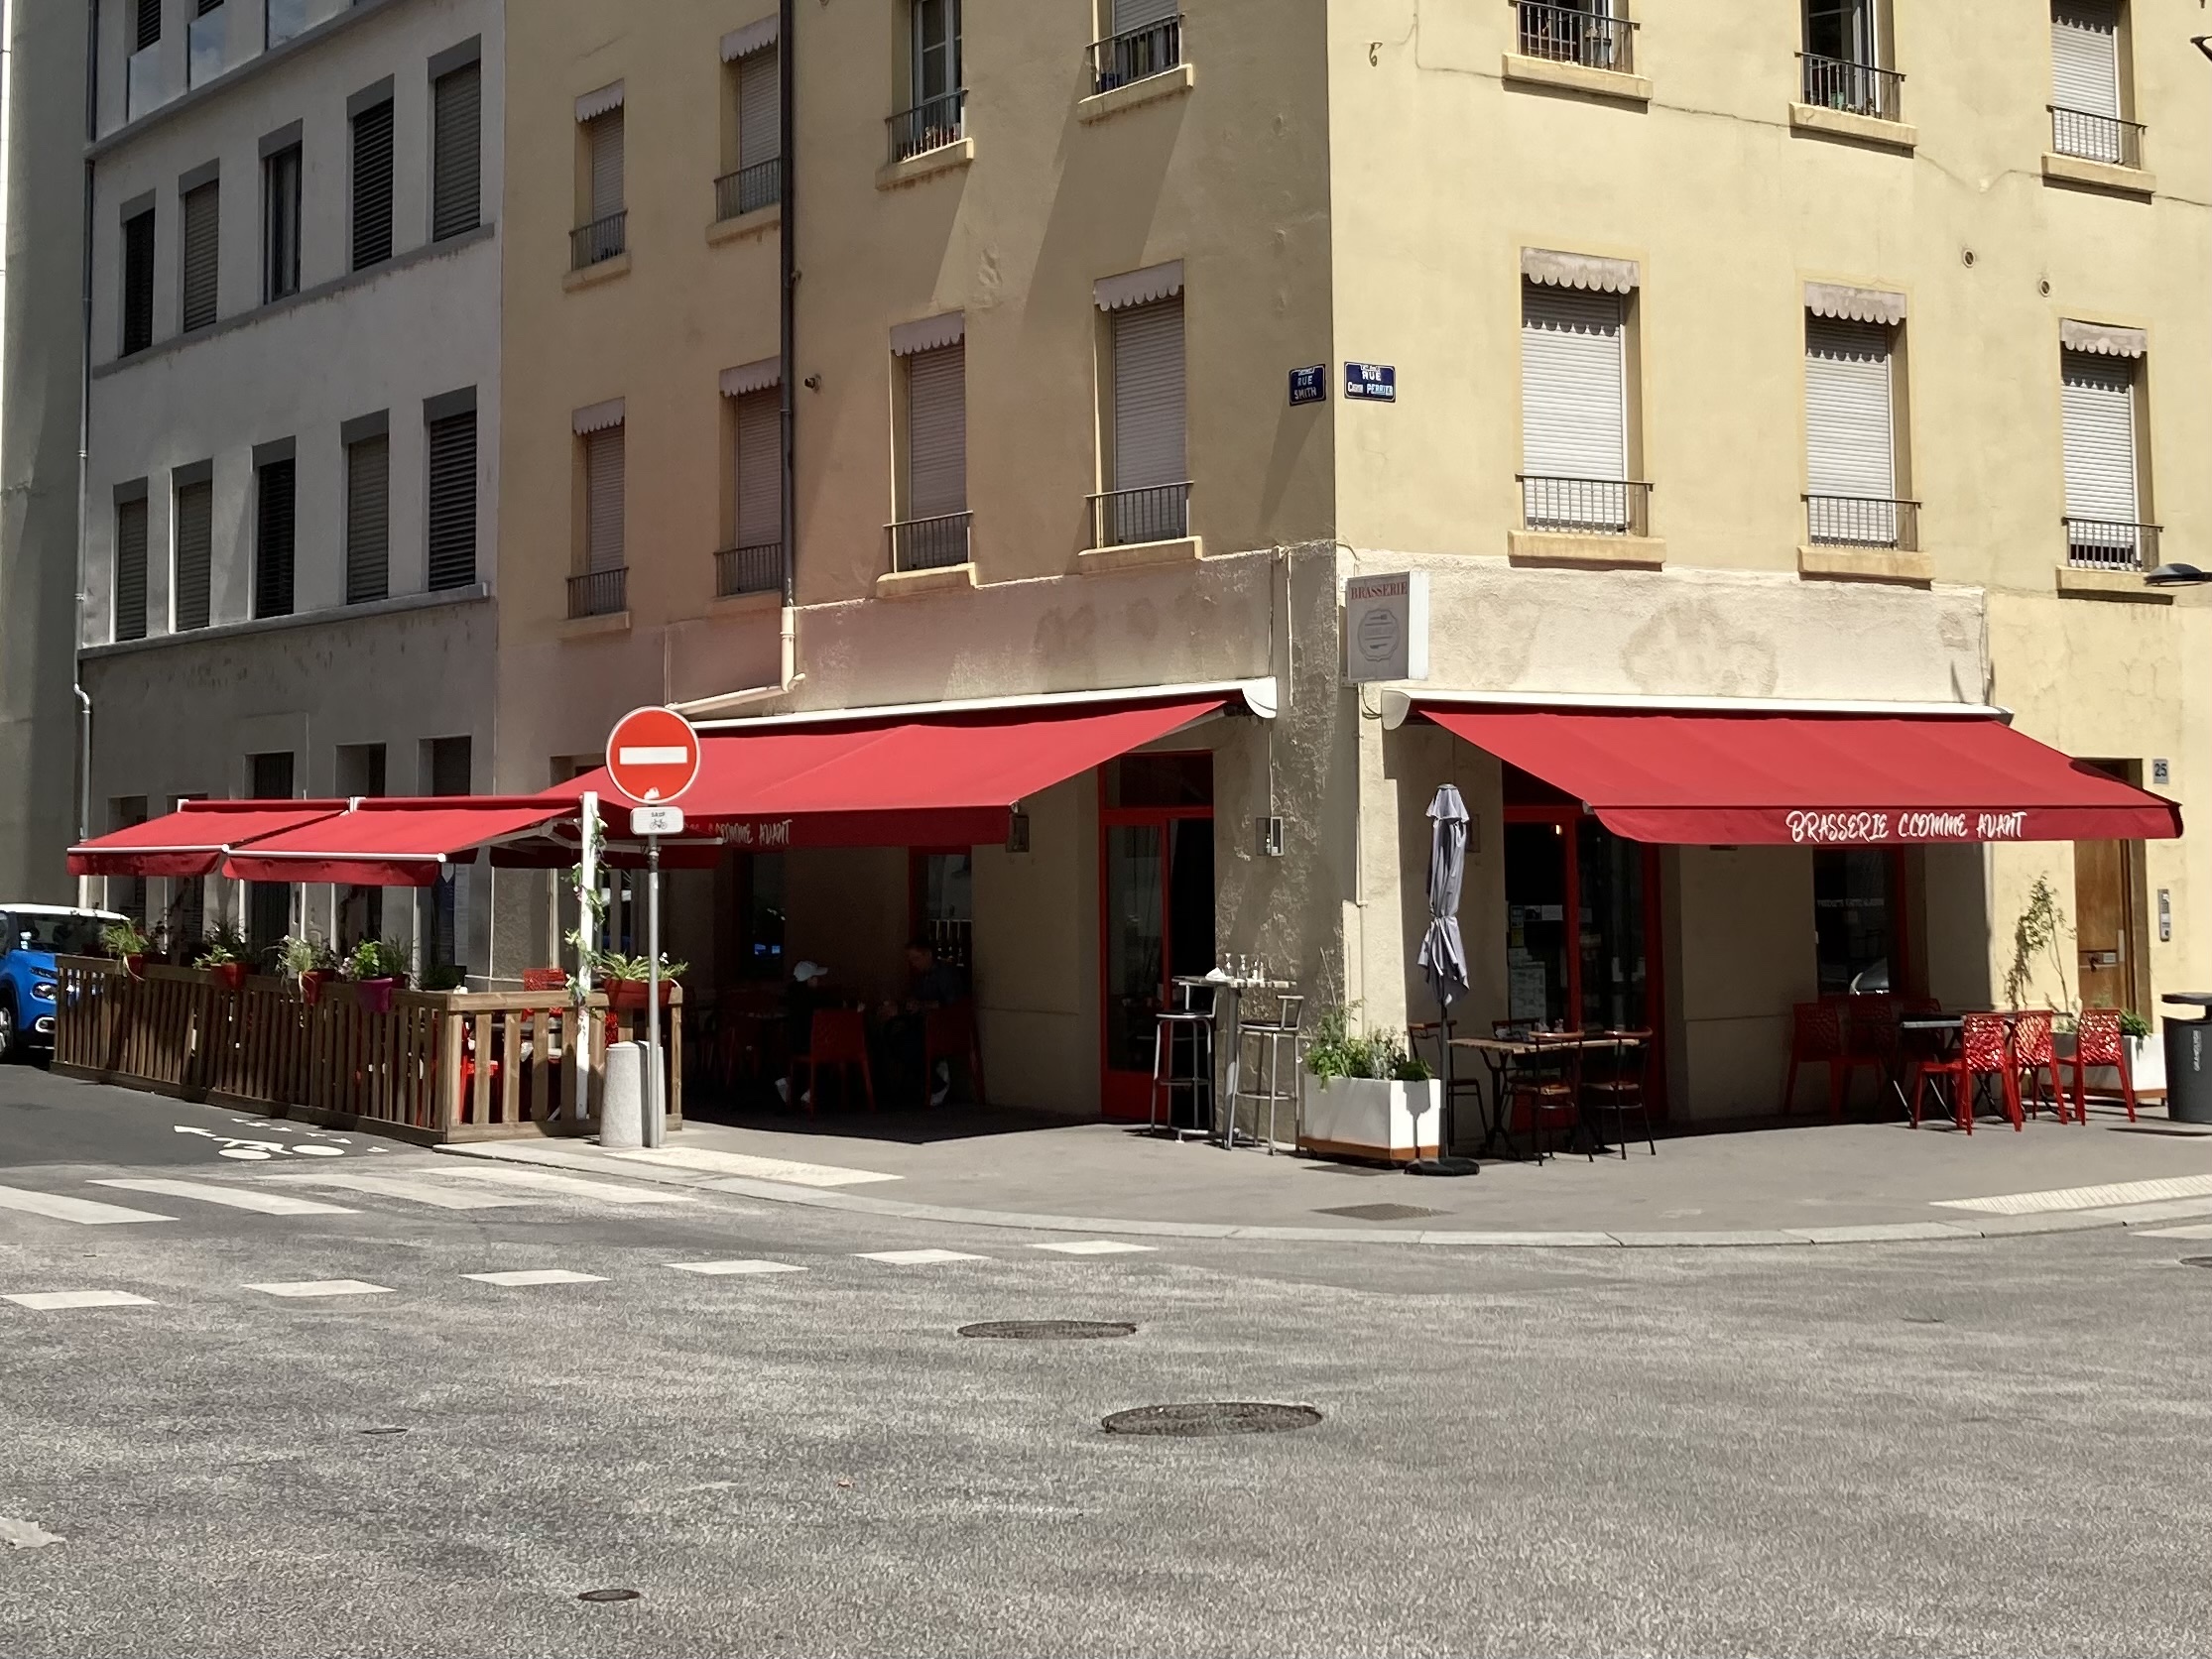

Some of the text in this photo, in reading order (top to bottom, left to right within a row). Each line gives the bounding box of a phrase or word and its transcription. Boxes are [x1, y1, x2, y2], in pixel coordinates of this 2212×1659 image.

[1297, 375, 1313, 387] RUE
[1361, 370, 1382, 381] RUE
[1293, 387, 1317, 401] SMITH
[1350, 581, 1408, 600] BRASSERIE
[2154, 763, 2167, 777] 25
[1785, 810, 1889, 843] BRASSERIE
[1976, 811, 2028, 839] AVANT
